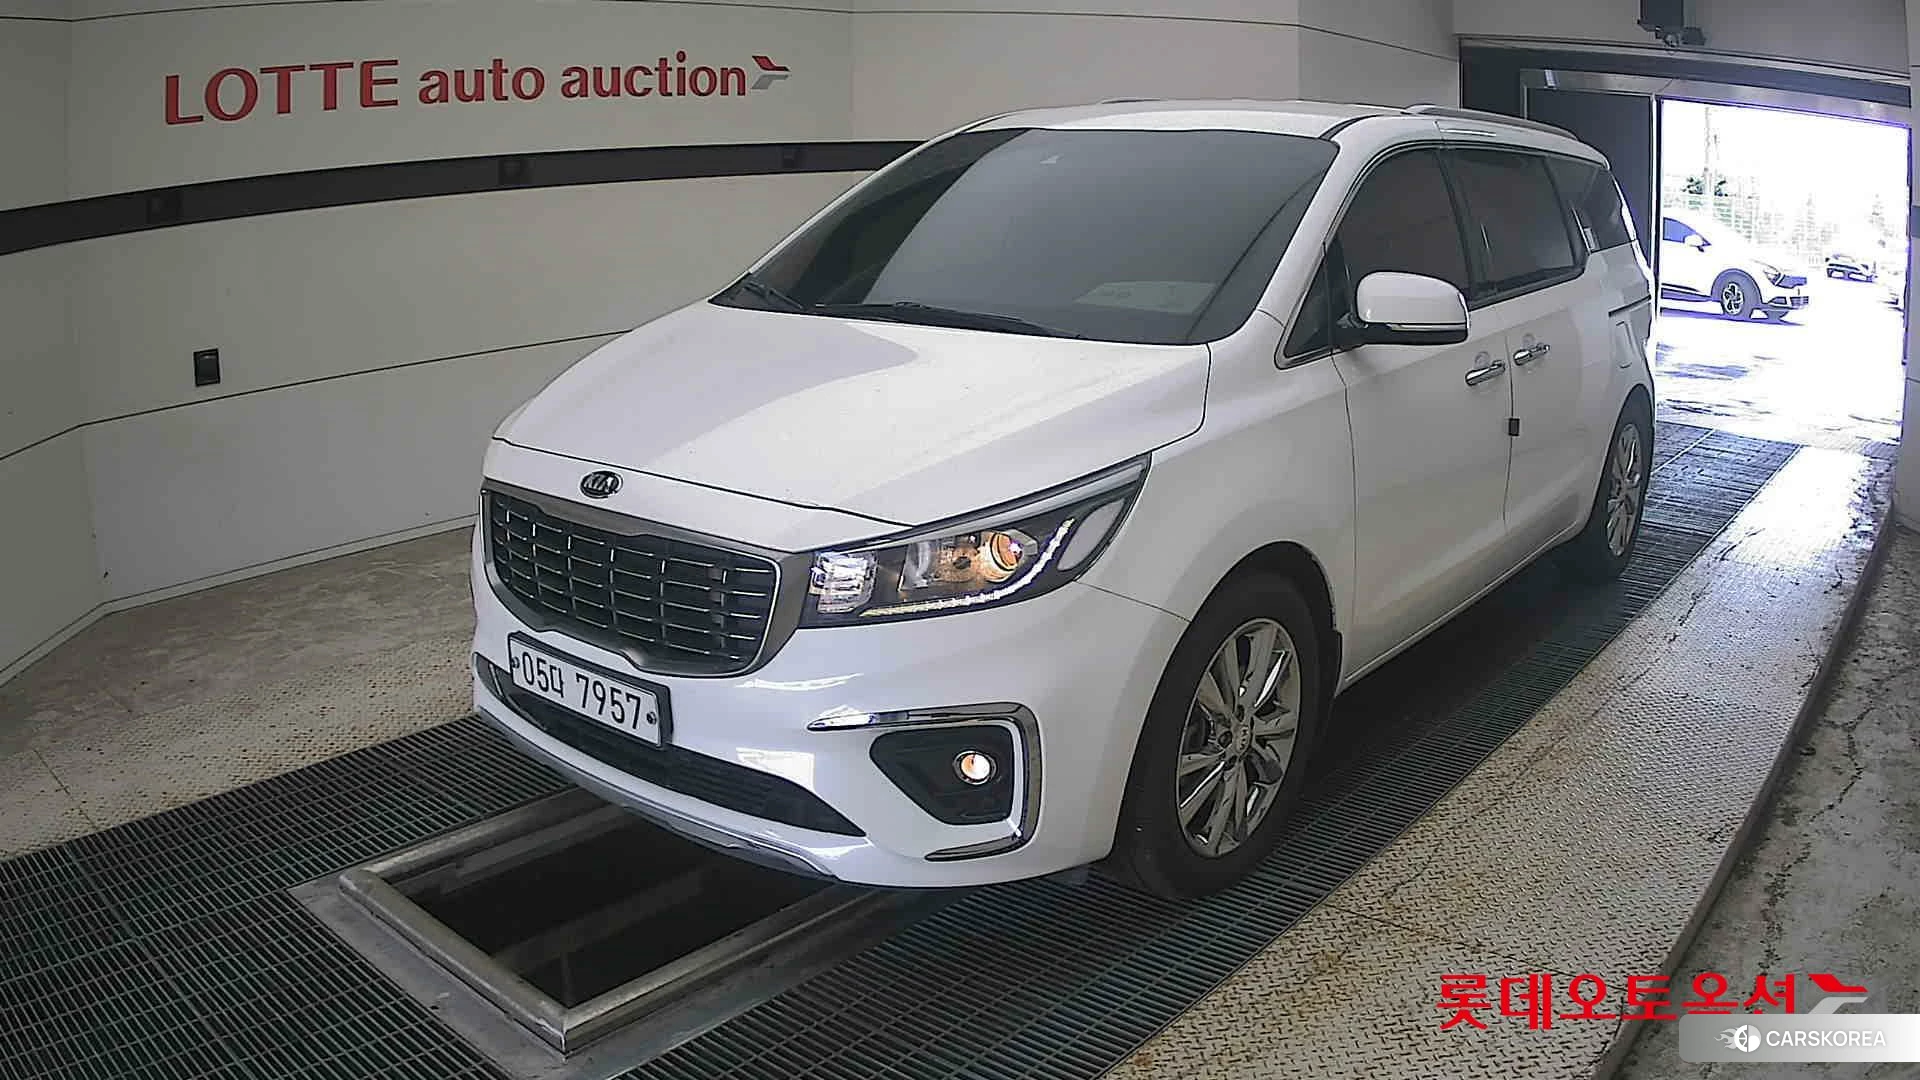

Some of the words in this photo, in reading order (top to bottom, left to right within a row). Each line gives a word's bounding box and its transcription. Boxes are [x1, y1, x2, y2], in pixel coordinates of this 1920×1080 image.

[165, 60, 400, 126] LOTTE
[418, 57, 546, 105] auto
[560, 50, 747, 98] auction
[581, 472, 620, 495] KIA
[575, 672, 641, 730] 7957
